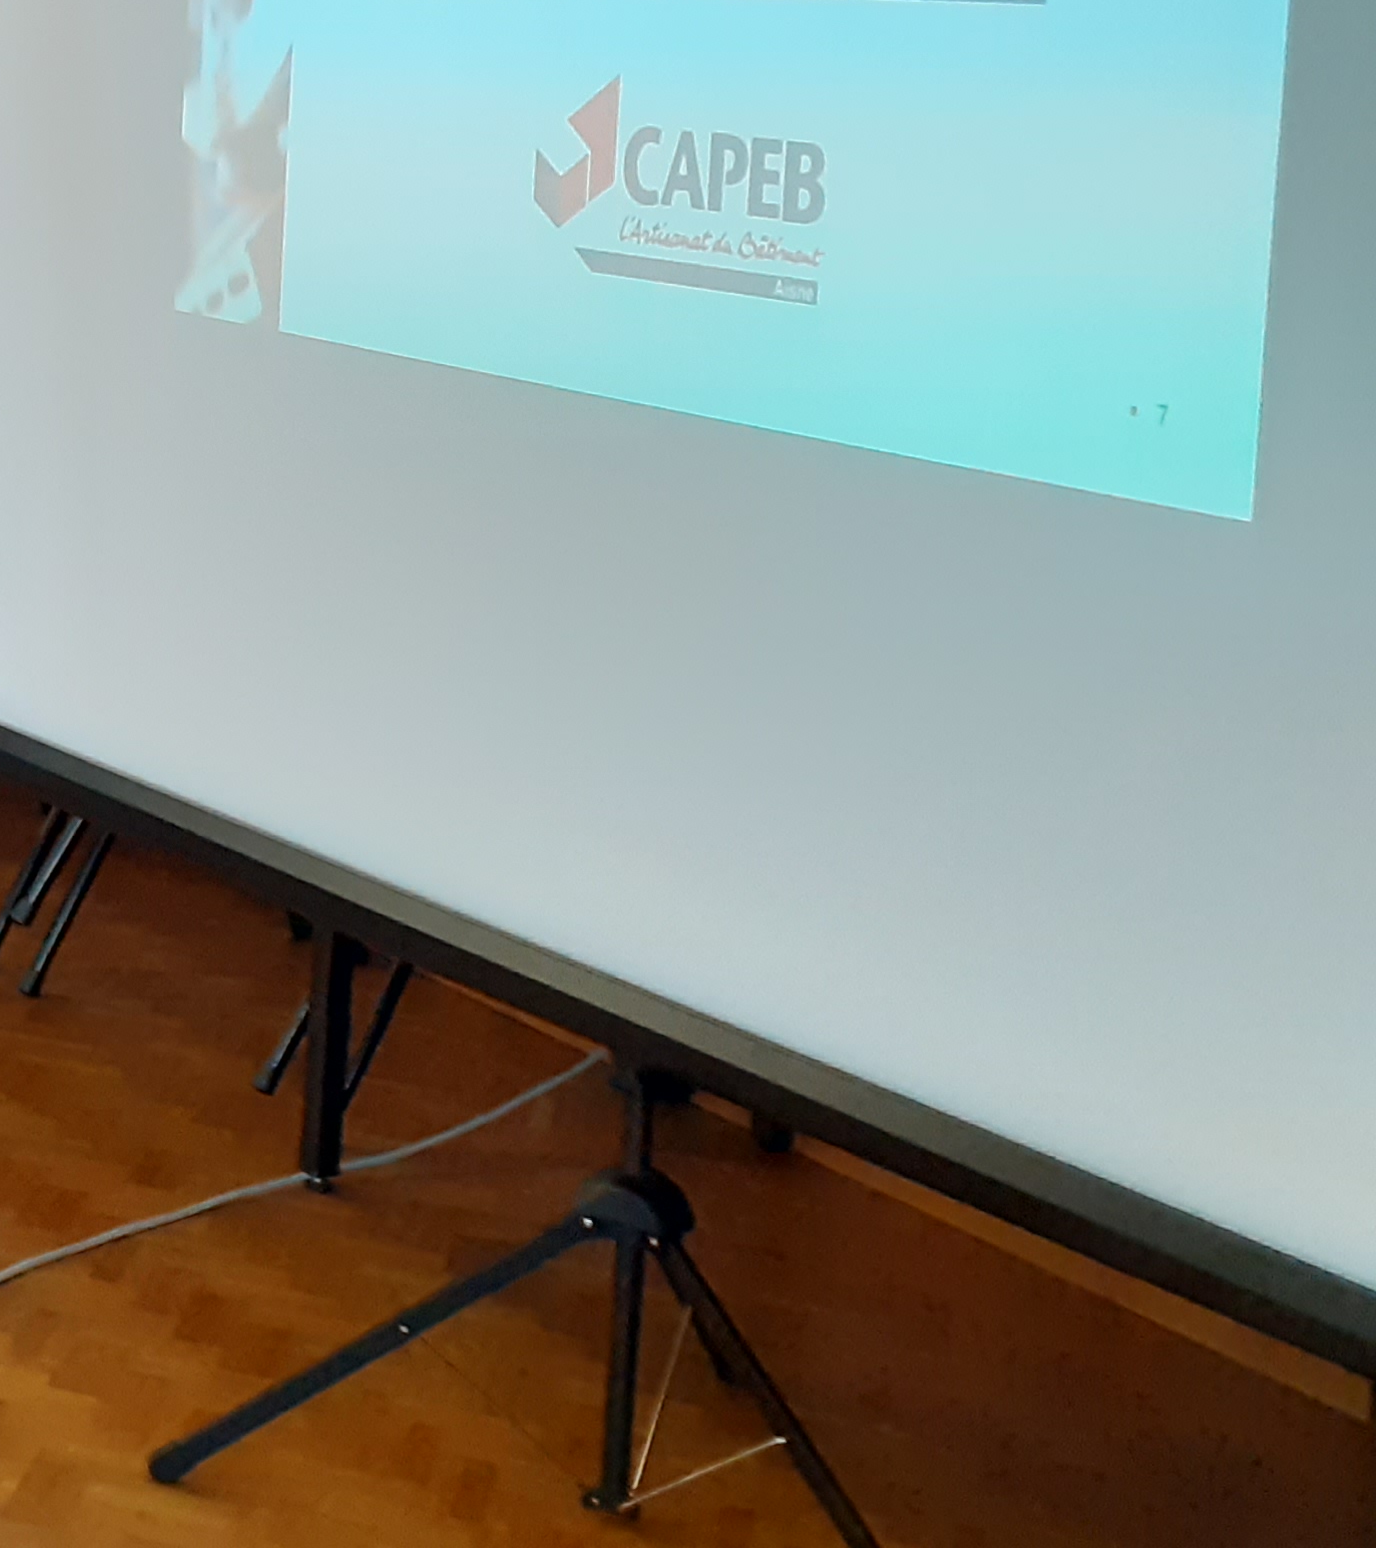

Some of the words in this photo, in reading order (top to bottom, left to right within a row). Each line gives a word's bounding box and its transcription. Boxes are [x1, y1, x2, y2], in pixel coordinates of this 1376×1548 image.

[622, 125, 827, 225] CAPEB
[773, 278, 814, 302] Aisne
[1156, 403, 1169, 425] 7
